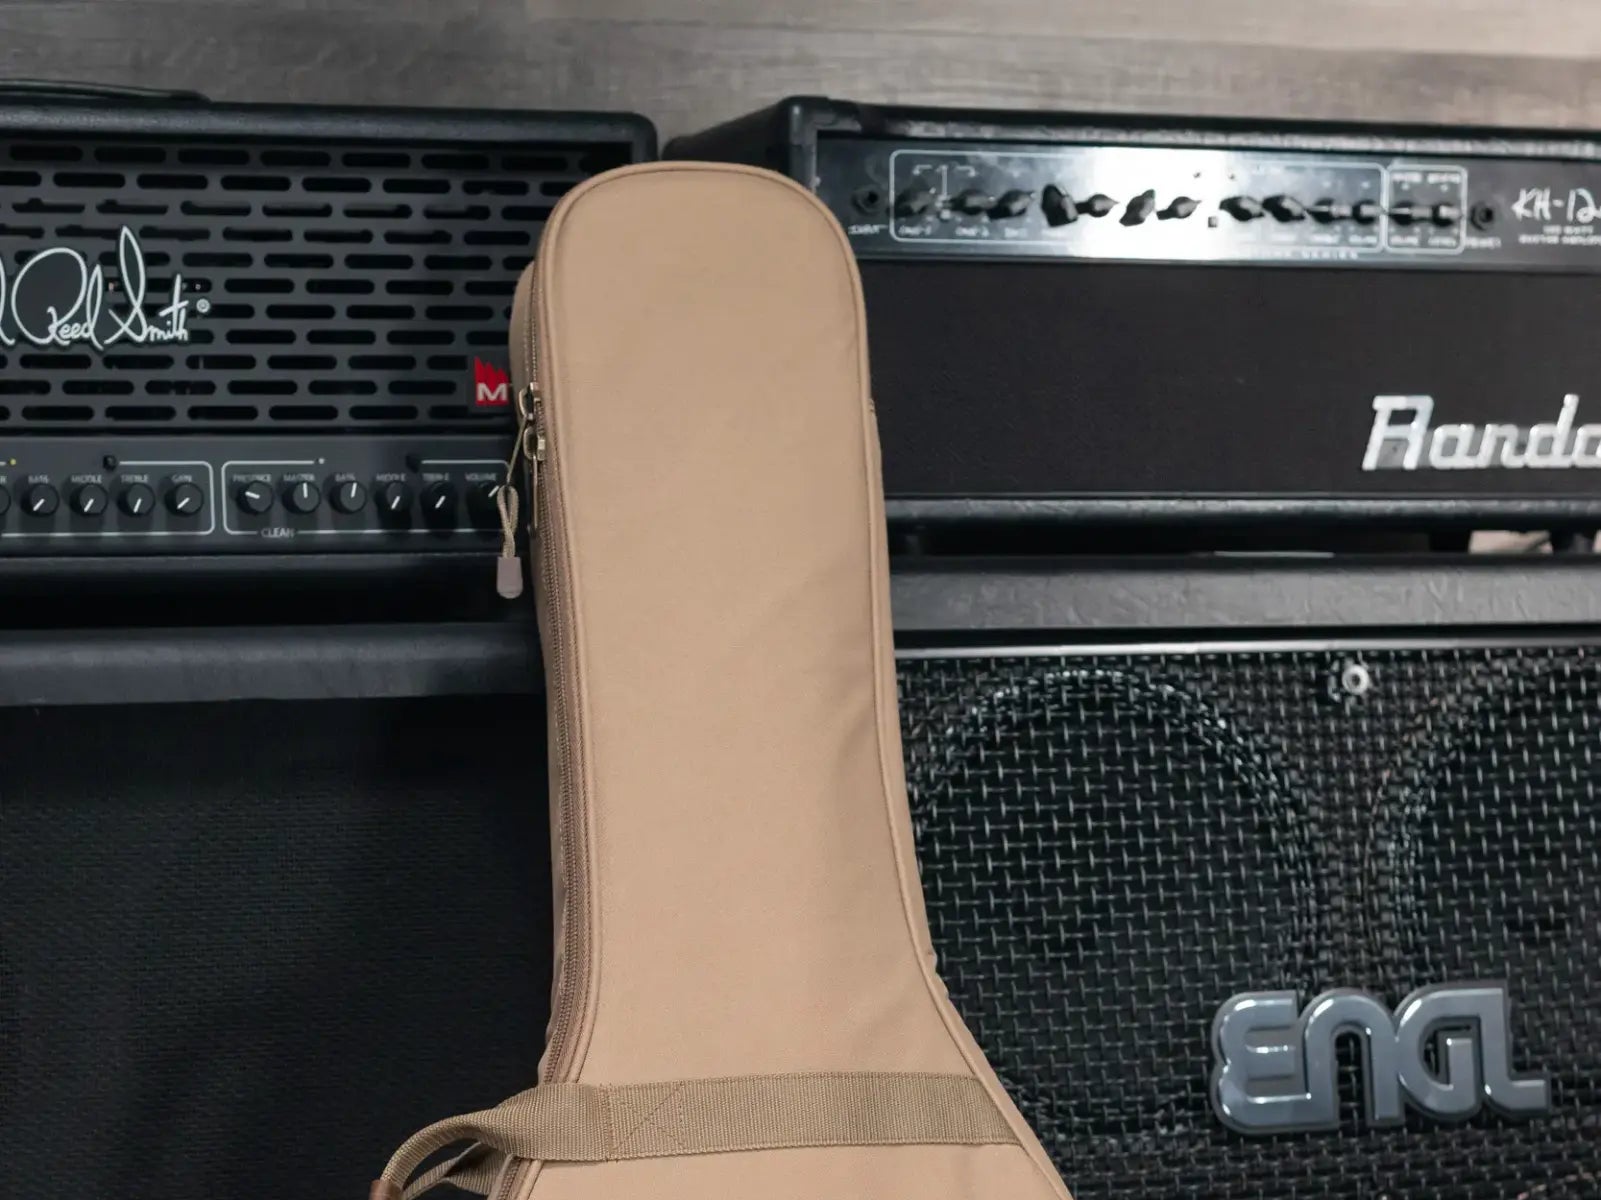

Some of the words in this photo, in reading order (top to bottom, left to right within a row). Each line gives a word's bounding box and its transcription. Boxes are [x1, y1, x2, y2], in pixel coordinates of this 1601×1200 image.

[11, 247, 104, 350] Reed
[104, 225, 189, 343] Smith
[261, 528, 296, 539] CLEAN
[1212, 980, 1547, 1134] ENGL
